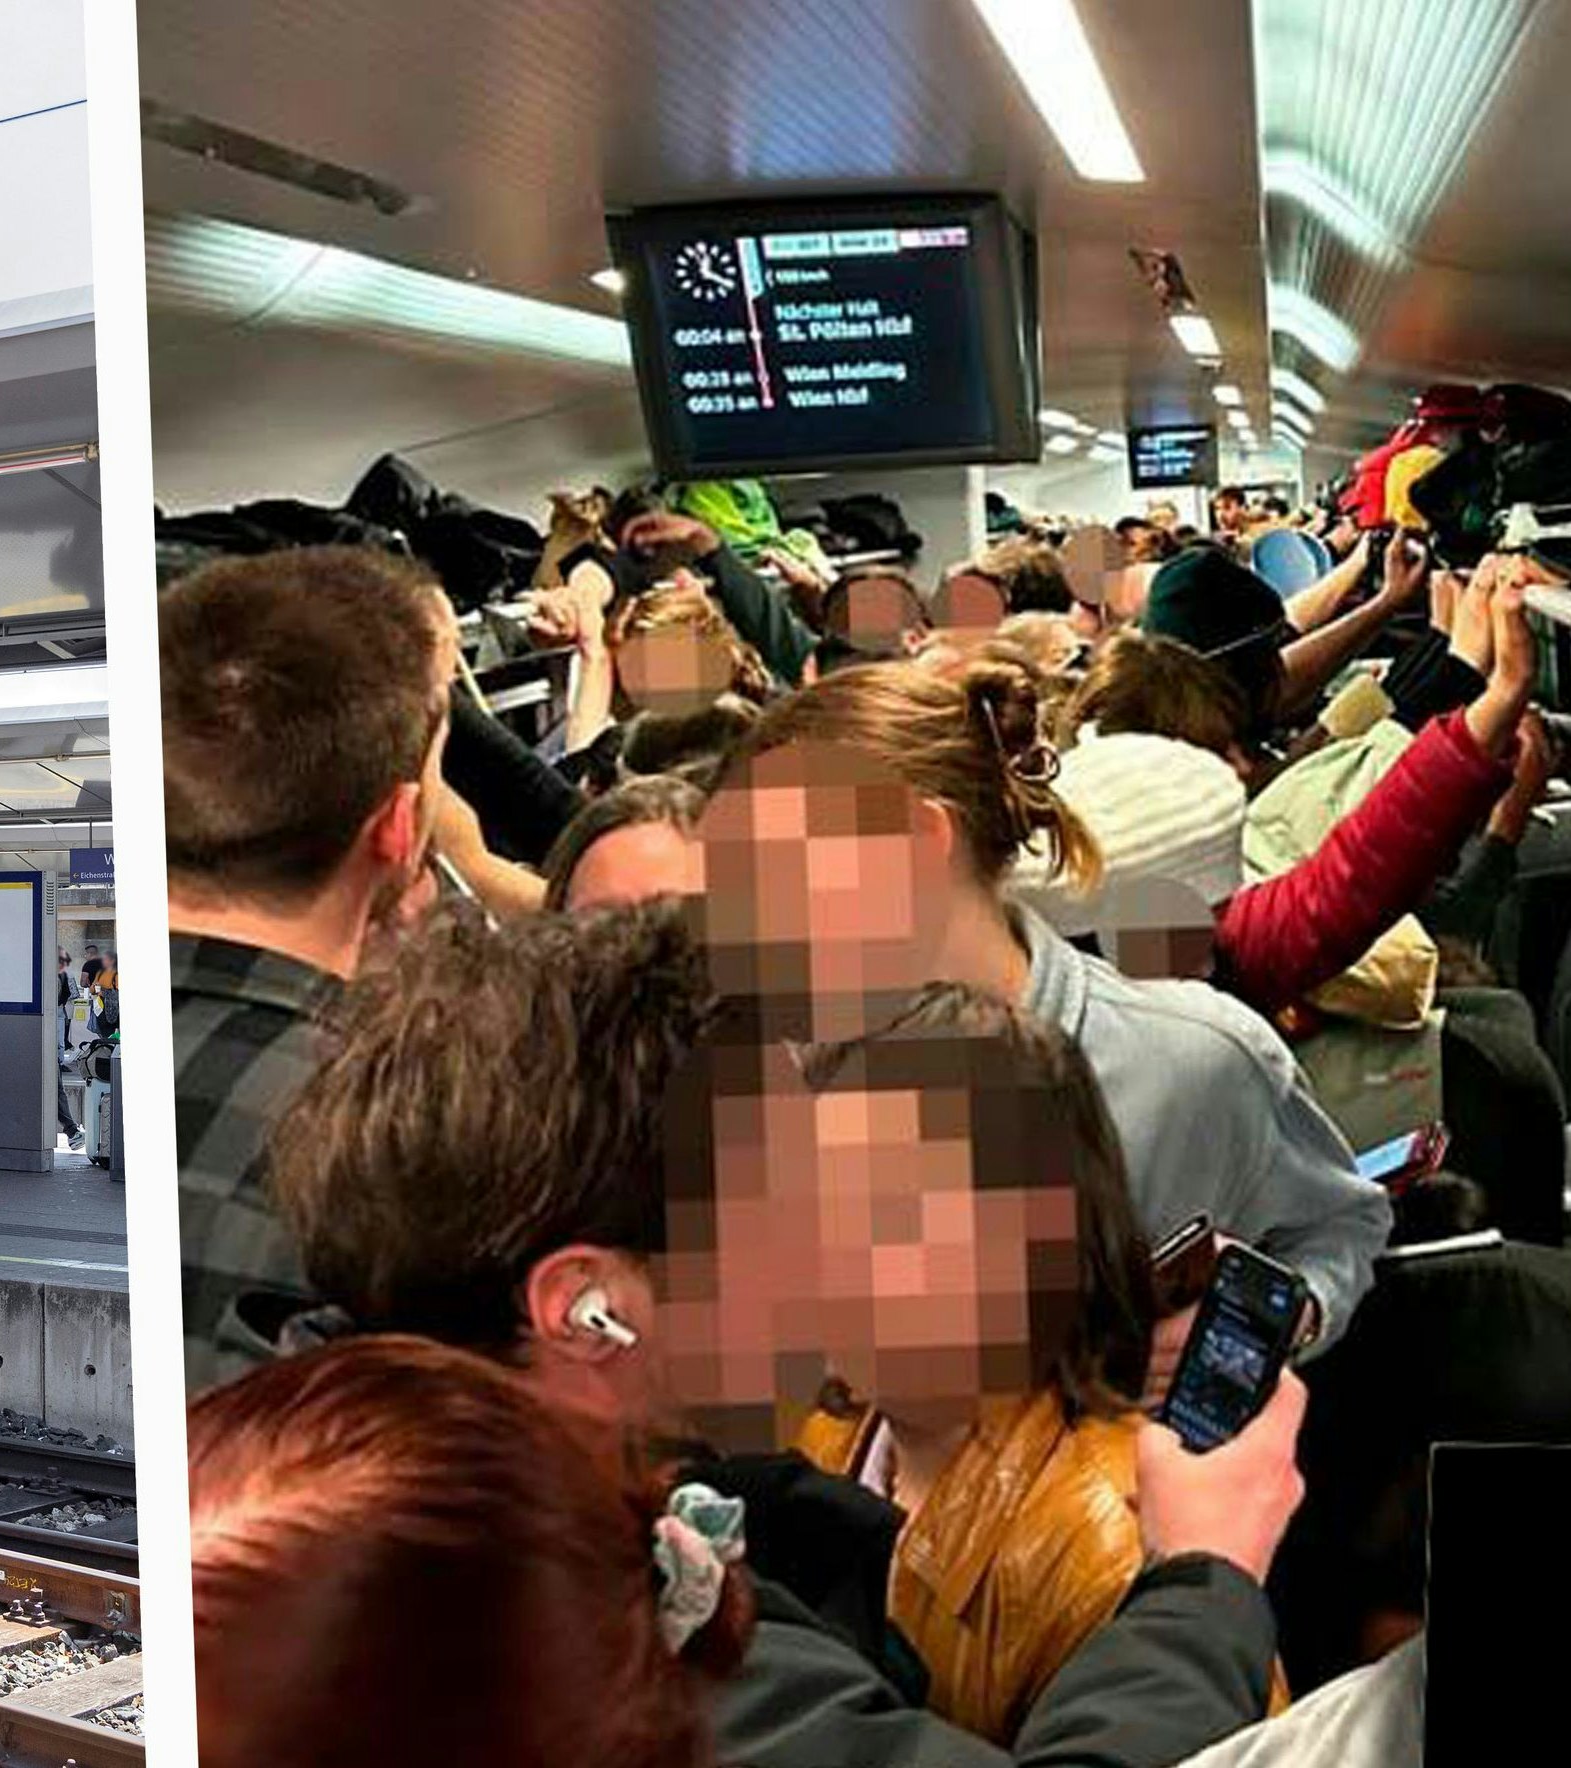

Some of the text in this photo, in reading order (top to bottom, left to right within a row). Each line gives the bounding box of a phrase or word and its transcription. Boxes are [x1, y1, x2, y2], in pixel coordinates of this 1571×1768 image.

[809, 319, 872, 340] Pölten
[782, 361, 907, 382] Wien Meidling
[787, 390, 834, 407] Wien
